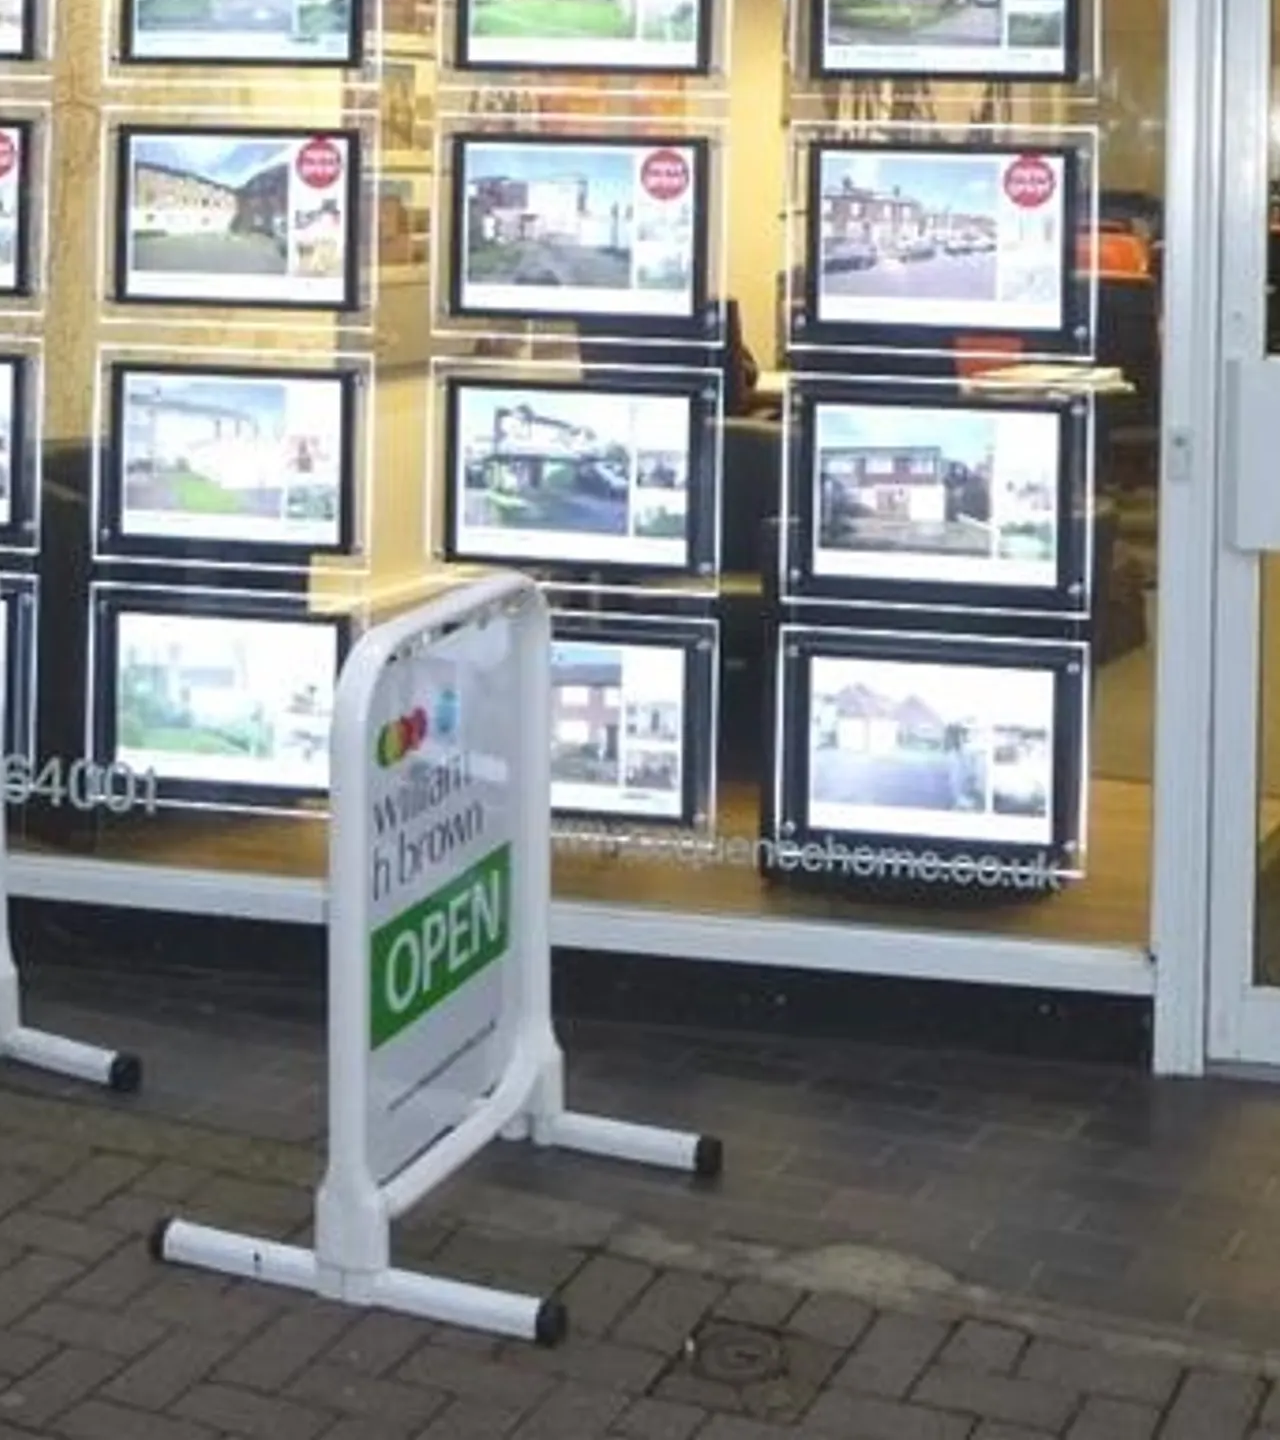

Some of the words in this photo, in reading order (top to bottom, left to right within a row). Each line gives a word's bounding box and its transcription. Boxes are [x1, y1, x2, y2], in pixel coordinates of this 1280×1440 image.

[373, 846, 390, 902] h
[399, 800, 484, 886] brown
[386, 869, 501, 1014] OPEN
